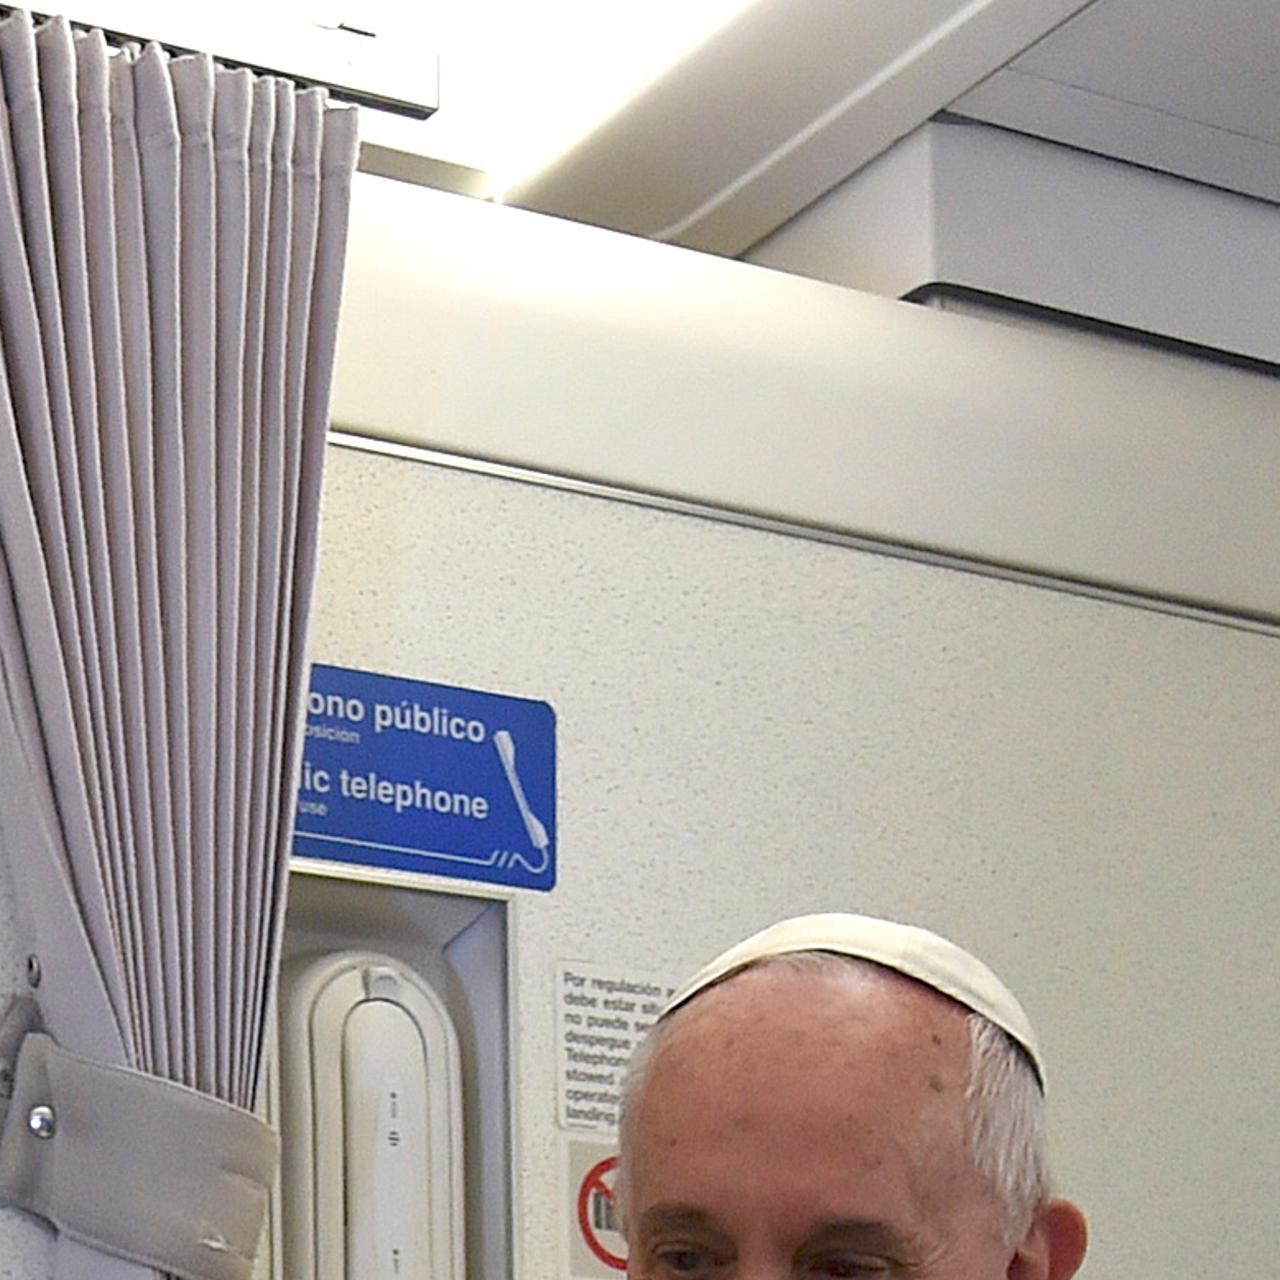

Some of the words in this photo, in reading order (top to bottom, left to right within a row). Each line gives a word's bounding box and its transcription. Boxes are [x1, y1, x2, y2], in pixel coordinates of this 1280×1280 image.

[308, 692, 365, 722] ono
[375, 700, 486, 743] público
[303, 762, 331, 793] ic
[339, 769, 489, 820] telephone
[563, 972, 586, 987] Por
[591, 979, 661, 997] regulación
[564, 994, 596, 1008] debe
[603, 999, 636, 1012] estar
[564, 1013, 581, 1025] no
[587, 1016, 629, 1031] puede
[565, 1030, 631, 1051] despegue
[565, 1047, 631, 1067] Telephon
[566, 1070, 615, 1086] stowed
[566, 1089, 621, 1105] operate
[567, 1106, 616, 1126] landing
